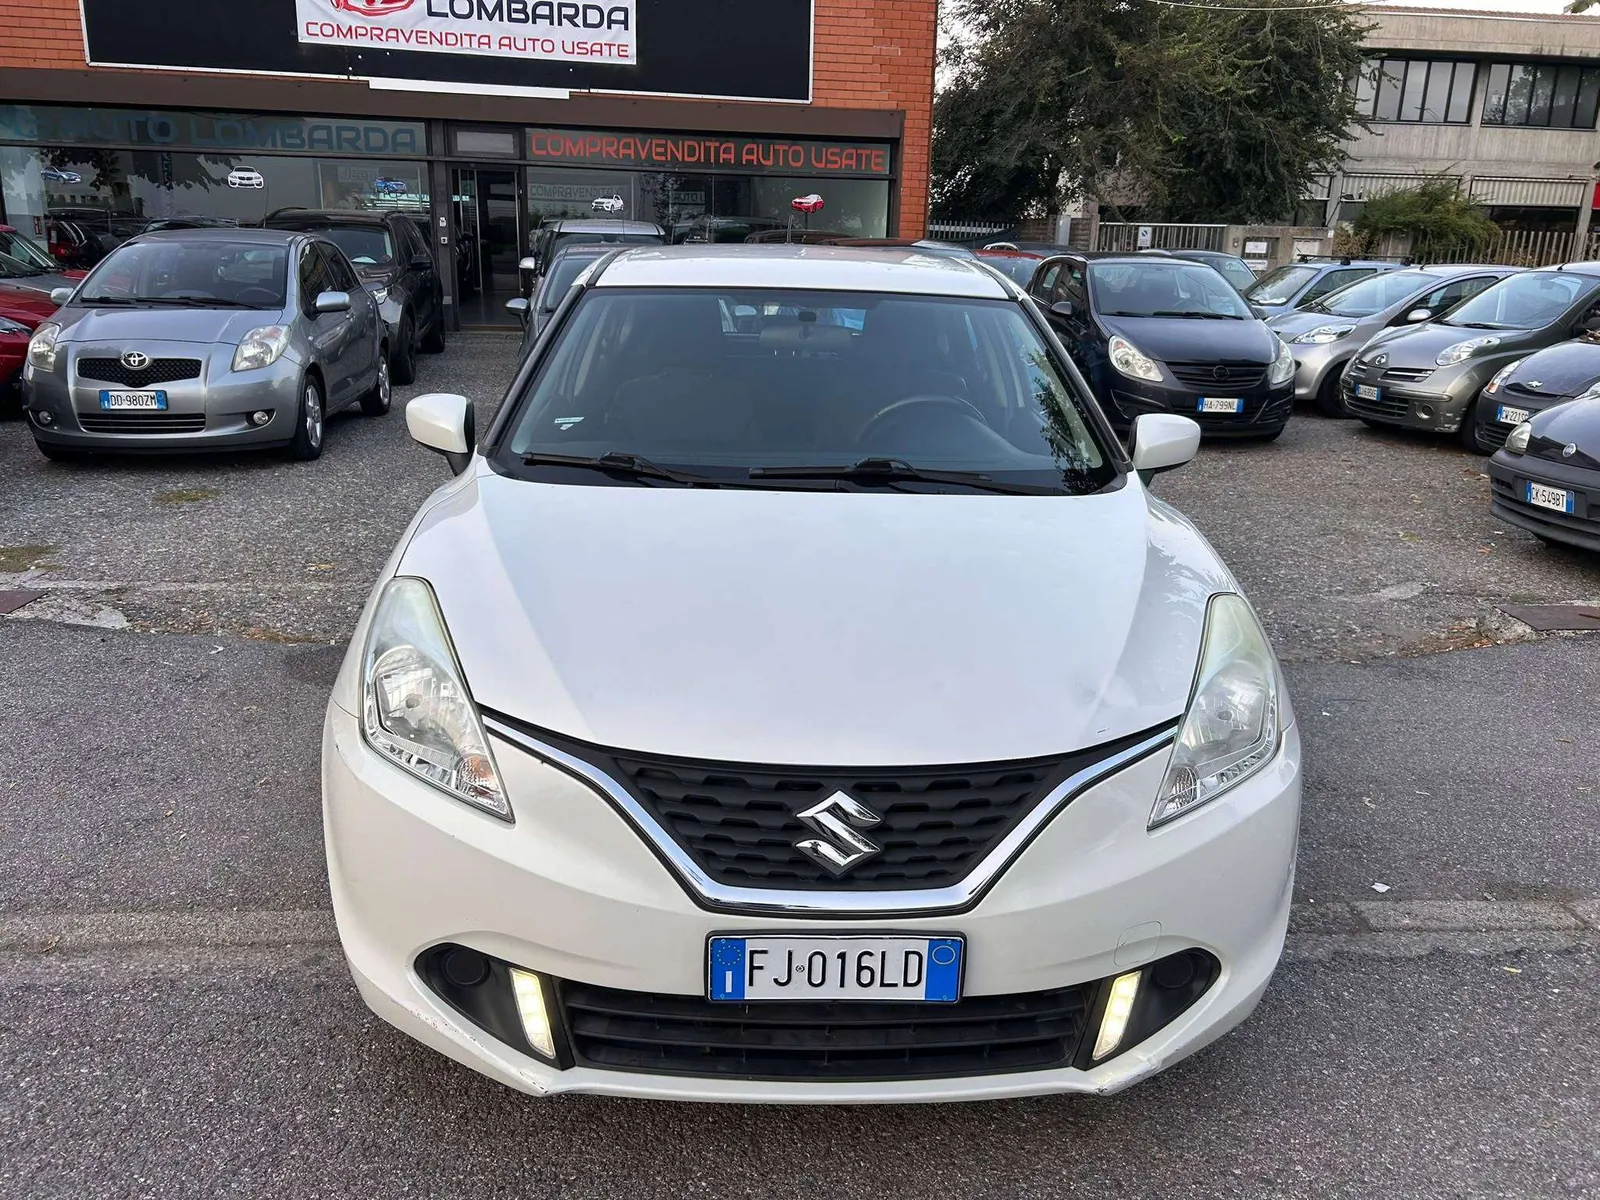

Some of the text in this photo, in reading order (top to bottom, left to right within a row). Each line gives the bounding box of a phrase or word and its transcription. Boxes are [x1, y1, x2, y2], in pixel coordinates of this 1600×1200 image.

[426, 0, 630, 31] LOMBARDA
[305, 21, 630, 58] COMPRAVENDITA AUTO USATE
[189, 116, 417, 153] LOMBARDA
[532, 133, 887, 172] COMPRAVENDITA AUTO USATE
